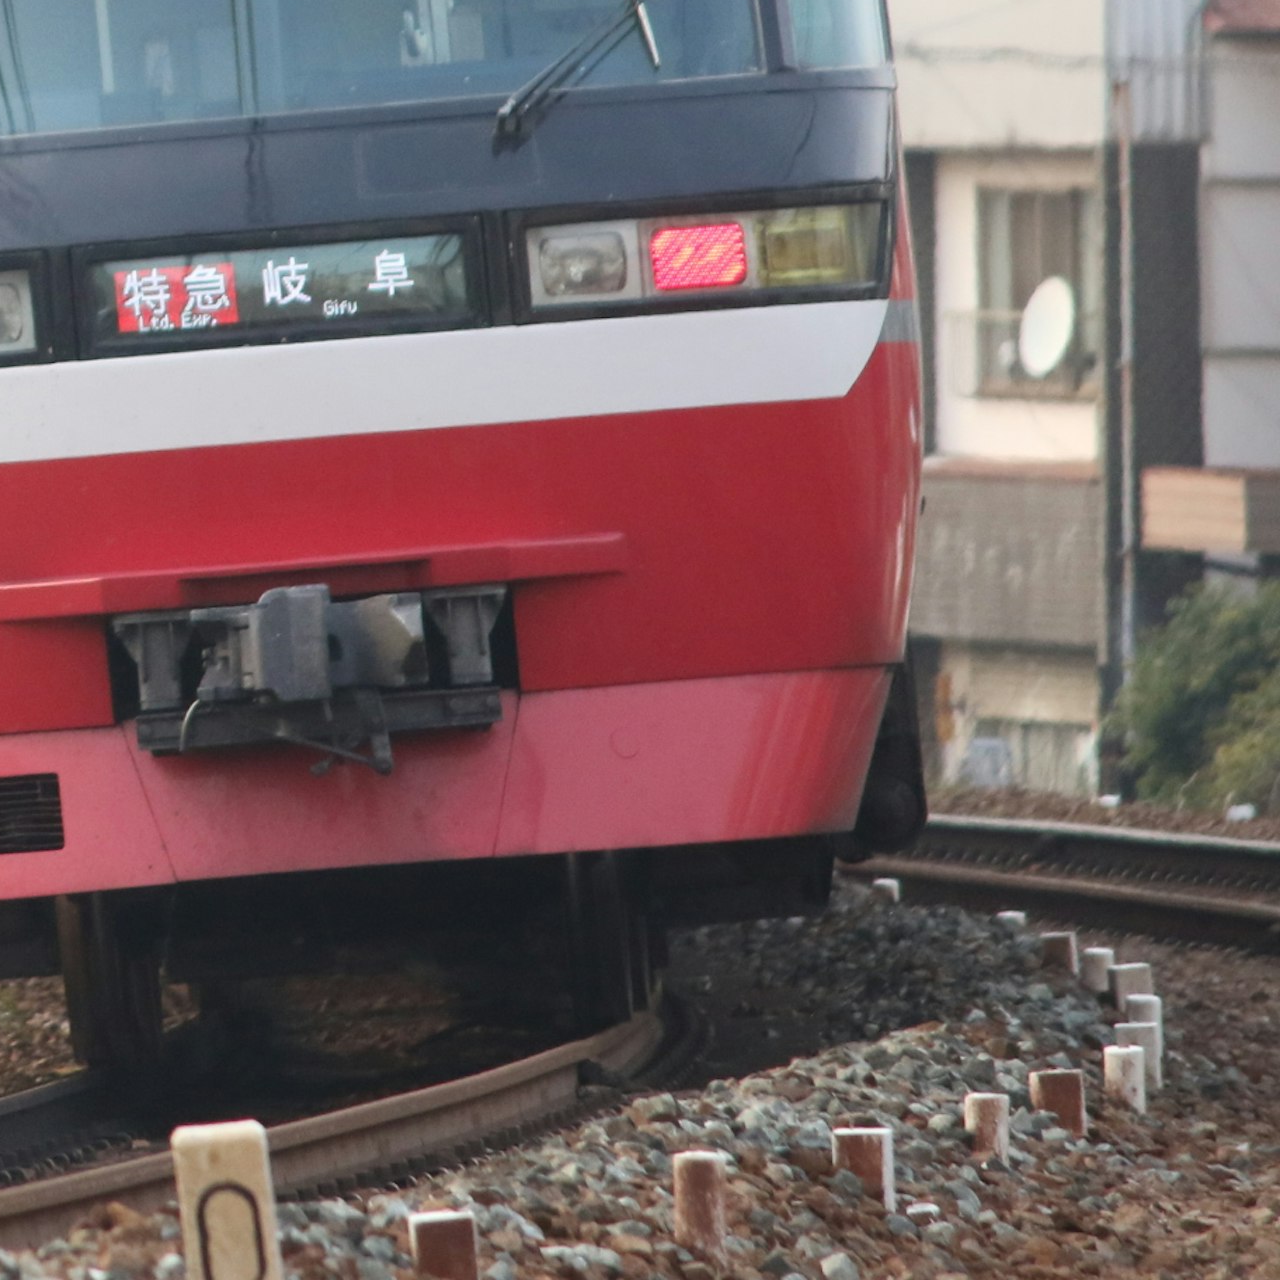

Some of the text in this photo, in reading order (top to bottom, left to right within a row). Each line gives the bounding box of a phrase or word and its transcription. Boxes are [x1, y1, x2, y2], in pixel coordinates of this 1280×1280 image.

[124, 249, 414, 316] 特急 岐阜
[323, 298, 358, 318] Gifu
[139, 314, 175, 332] Ltd.
